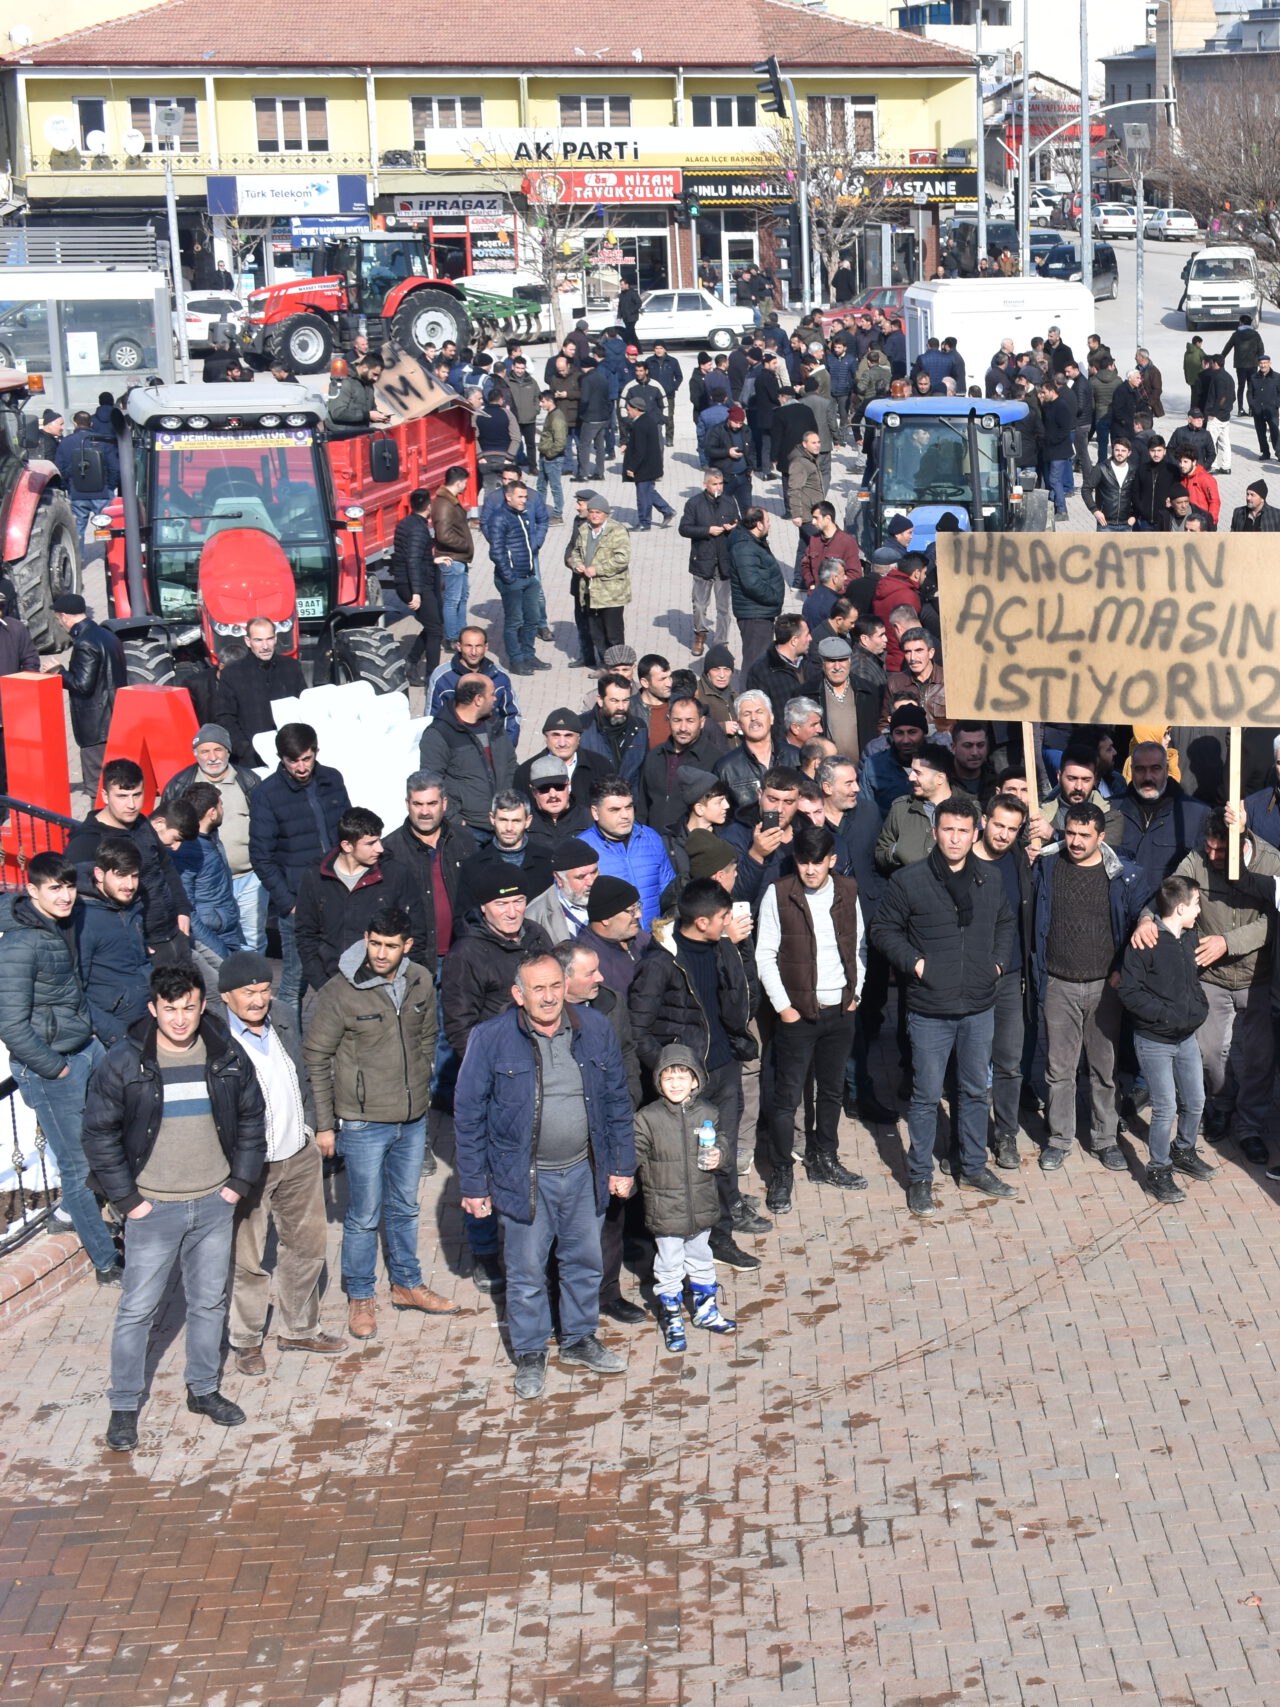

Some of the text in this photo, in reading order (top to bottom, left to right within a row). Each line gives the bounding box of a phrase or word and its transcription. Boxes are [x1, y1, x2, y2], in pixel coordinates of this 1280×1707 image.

[1017, 103, 1040, 113] ÖCAN
[1057, 104, 1080, 113] MARKE
[514, 142, 553, 161] AK
[624, 173, 674, 186] NİZAM
[245, 189, 312, 199] Türk Telekom
[573, 186, 675, 201] TAVUKÇULUK
[883, 181, 957, 196] PASTANE
[301, 238, 307, 247] 3
[305, 599, 321, 608] AAT
